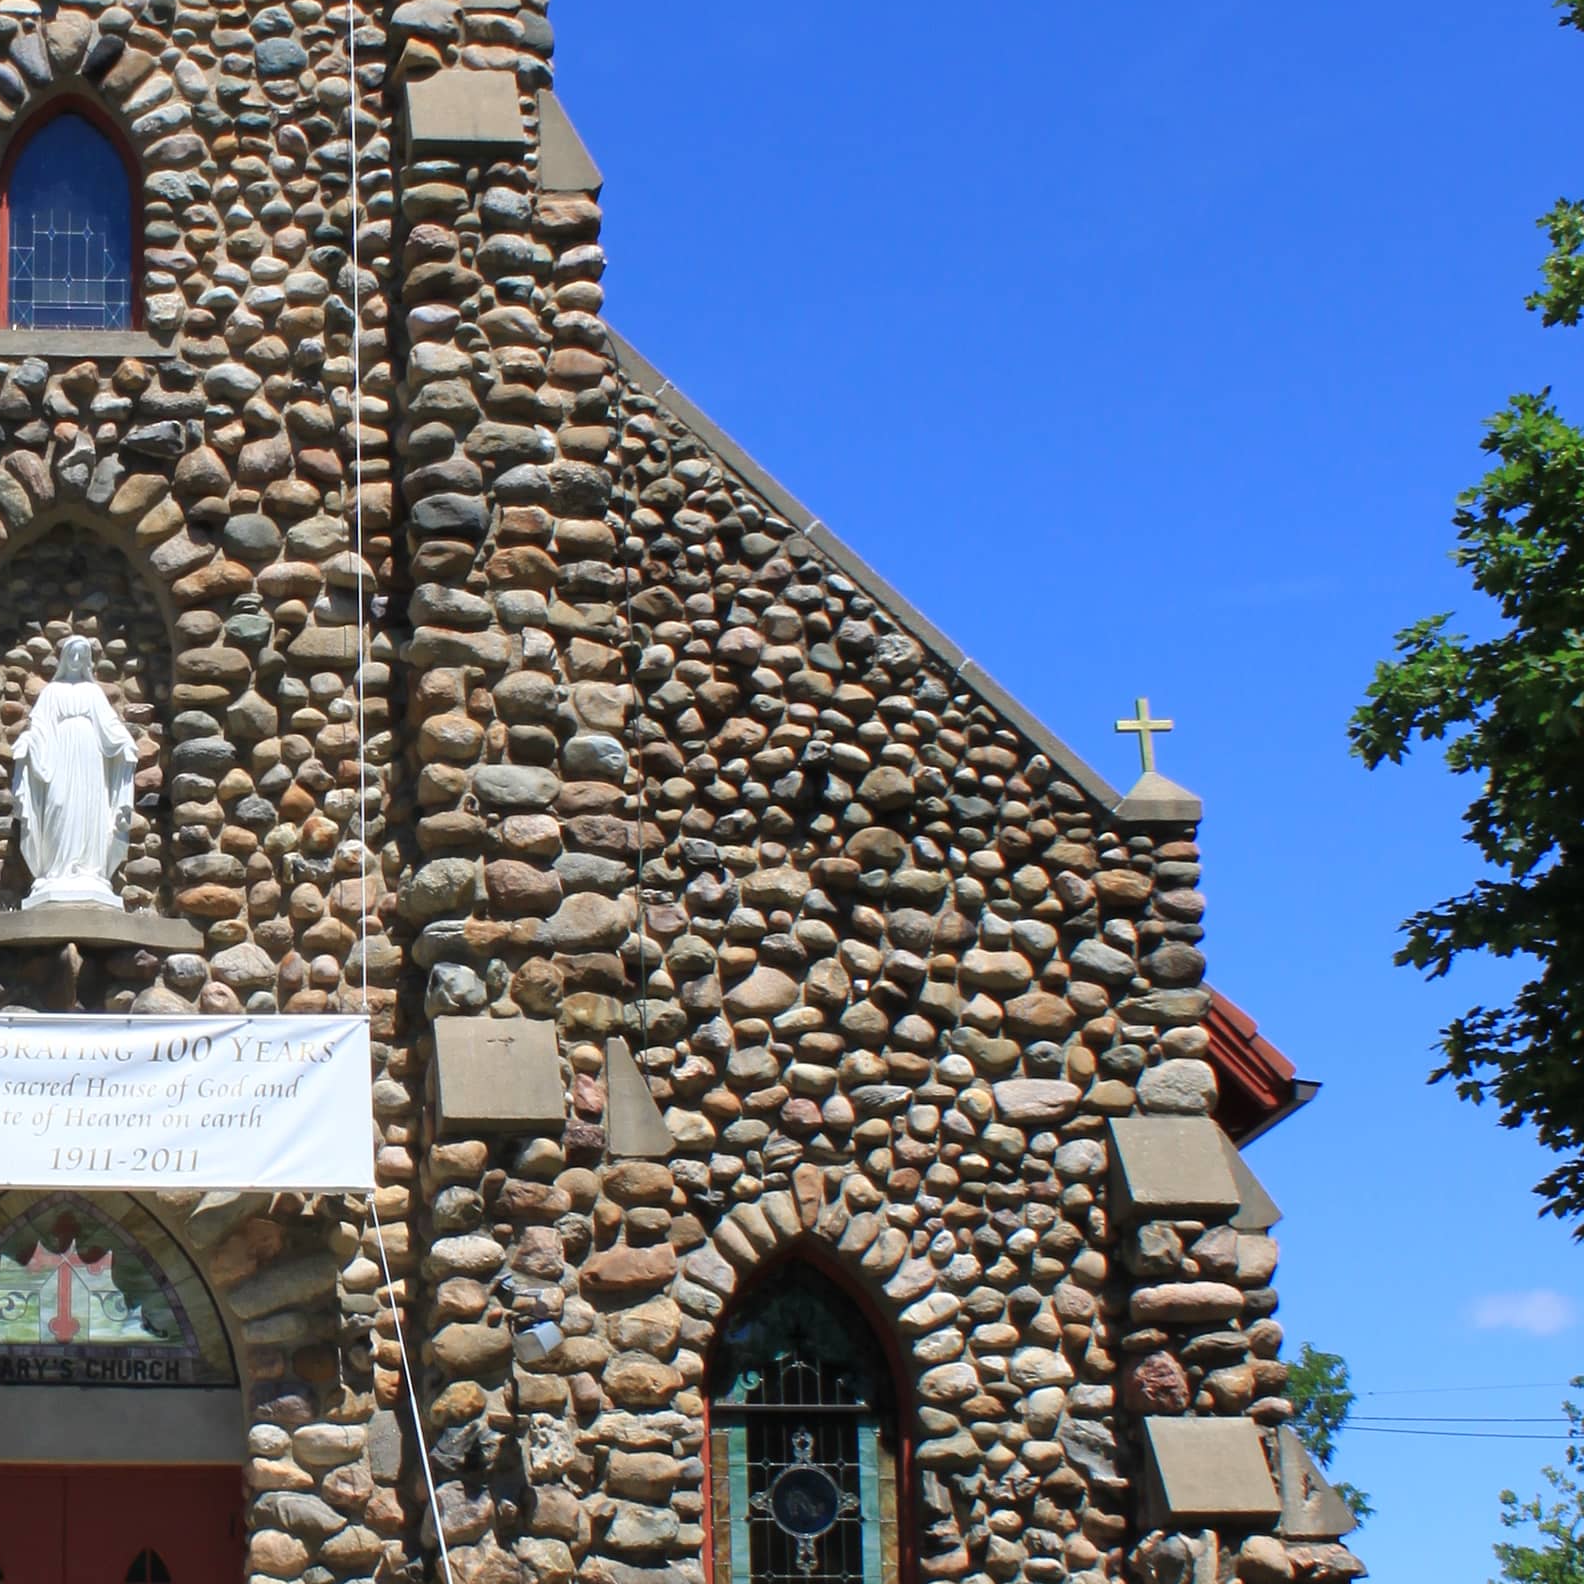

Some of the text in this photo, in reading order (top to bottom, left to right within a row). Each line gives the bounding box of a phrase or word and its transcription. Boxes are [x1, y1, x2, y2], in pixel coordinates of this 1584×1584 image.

[148, 1035, 213, 1063] 100
[230, 1036, 336, 1064] YEARS
[3, 1073, 80, 1097] sacred
[86, 1077, 157, 1098] House
[166, 1074, 193, 1108] of
[197, 1074, 249, 1098] God
[254, 1075, 304, 1098] and
[31, 1103, 59, 1136] of
[64, 1107, 151, 1128] Heaven
[162, 1115, 189, 1128] on
[201, 1104, 262, 1128] earth
[49, 1147, 198, 1172] 1911-2011
[86, 1359, 180, 1381] CHURCH
